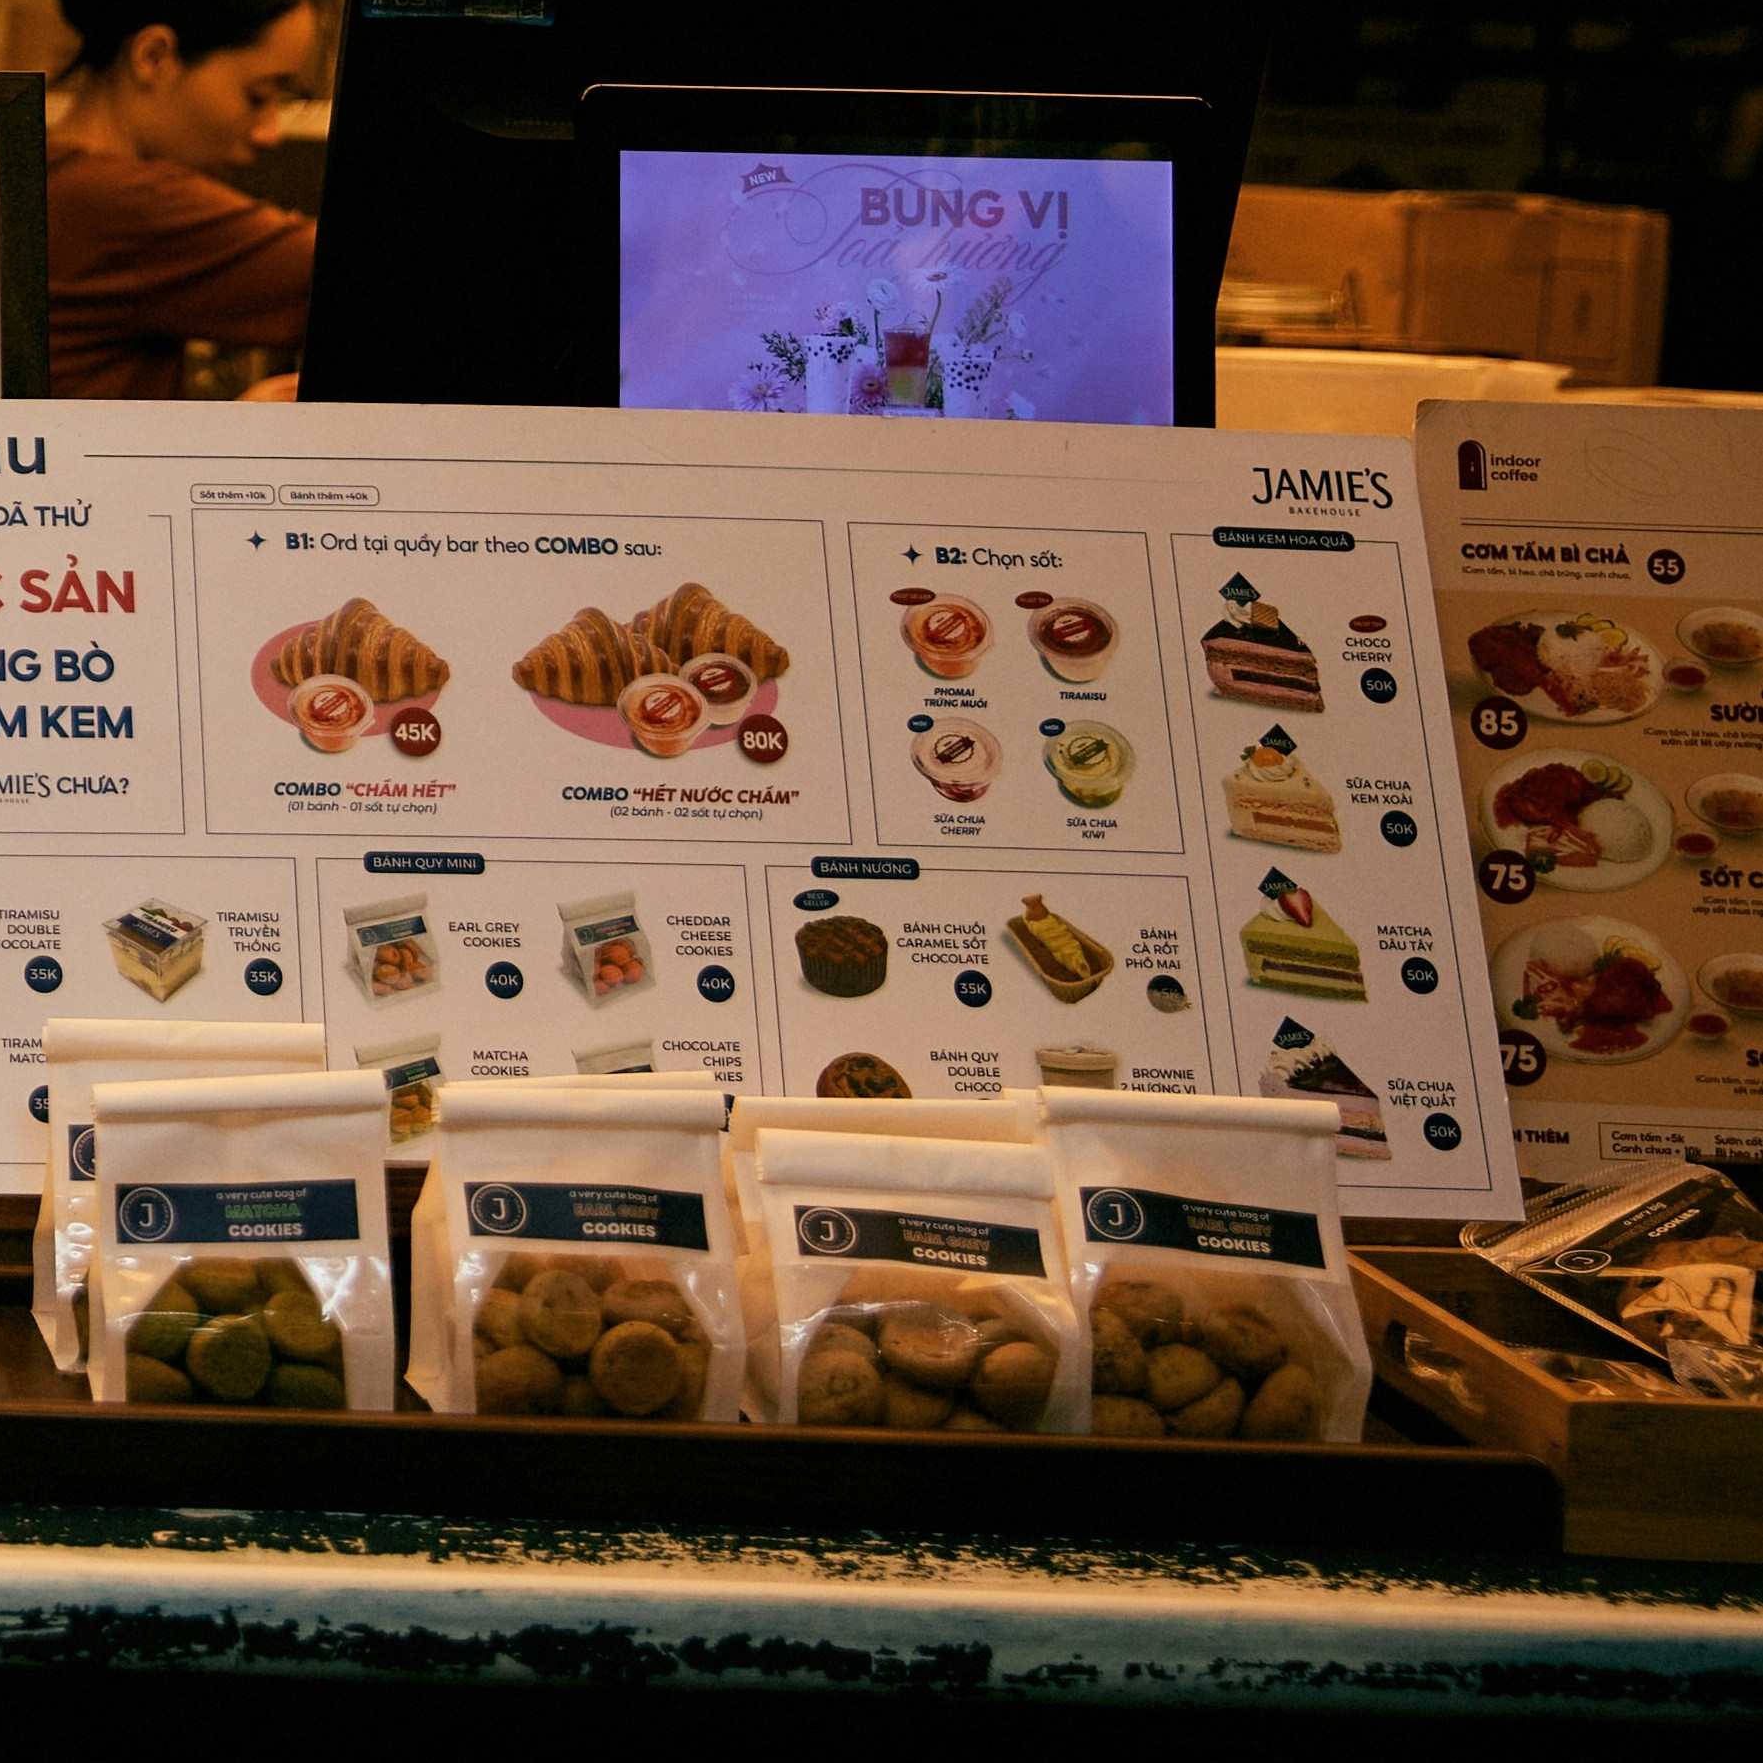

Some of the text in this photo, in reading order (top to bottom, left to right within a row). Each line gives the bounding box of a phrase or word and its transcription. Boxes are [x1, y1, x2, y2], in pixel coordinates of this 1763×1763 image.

[748, 169, 777, 187] NEW
[861, 187, 1068, 239] BUNG VỊ
[1491, 454, 1541, 467] indoor
[1491, 469, 1538, 481] coffee
[34, 499, 92, 527] THỬ
[1288, 506, 1360, 517] BAKEHOUSE
[286, 533, 661, 557] B1: Ord tại quầy bar theo COMBO sau:
[1461, 541, 1630, 564] CƠM TẤM BÌ CHẢ
[936, 547, 1063, 571] B2: Chọn sốt:
[1653, 558, 1679, 576] 55
[20, 554, 135, 613] SẢN
[55, 641, 114, 682] BÒ
[41, 706, 133, 739] KEM
[1480, 709, 1518, 736] 85
[395, 723, 435, 741] 45K
[744, 731, 783, 750] 80K
[56, 775, 129, 794] CHƯA?
[1489, 864, 1526, 890] 75
[7, 924, 60, 935] DOUBLE
[449, 922, 519, 933] EARL GREY
[1377, 926, 1432, 937] MATCHA
[463, 937, 521, 948] COOKIES
[1379, 938, 1433, 951] DÂU TÂY
[30, 968, 57, 980] 35K
[490, 974, 518, 985] 40K
[1407, 970, 1434, 981] 50K
[225, 1203, 301, 1220] MATCHA
[229, 1223, 303, 1237] COOKIES
[582, 1222, 656, 1238] COOKIES
[1198, 1235, 1270, 1253] COOKIES
[913, 1247, 988, 1266] COOKIES
